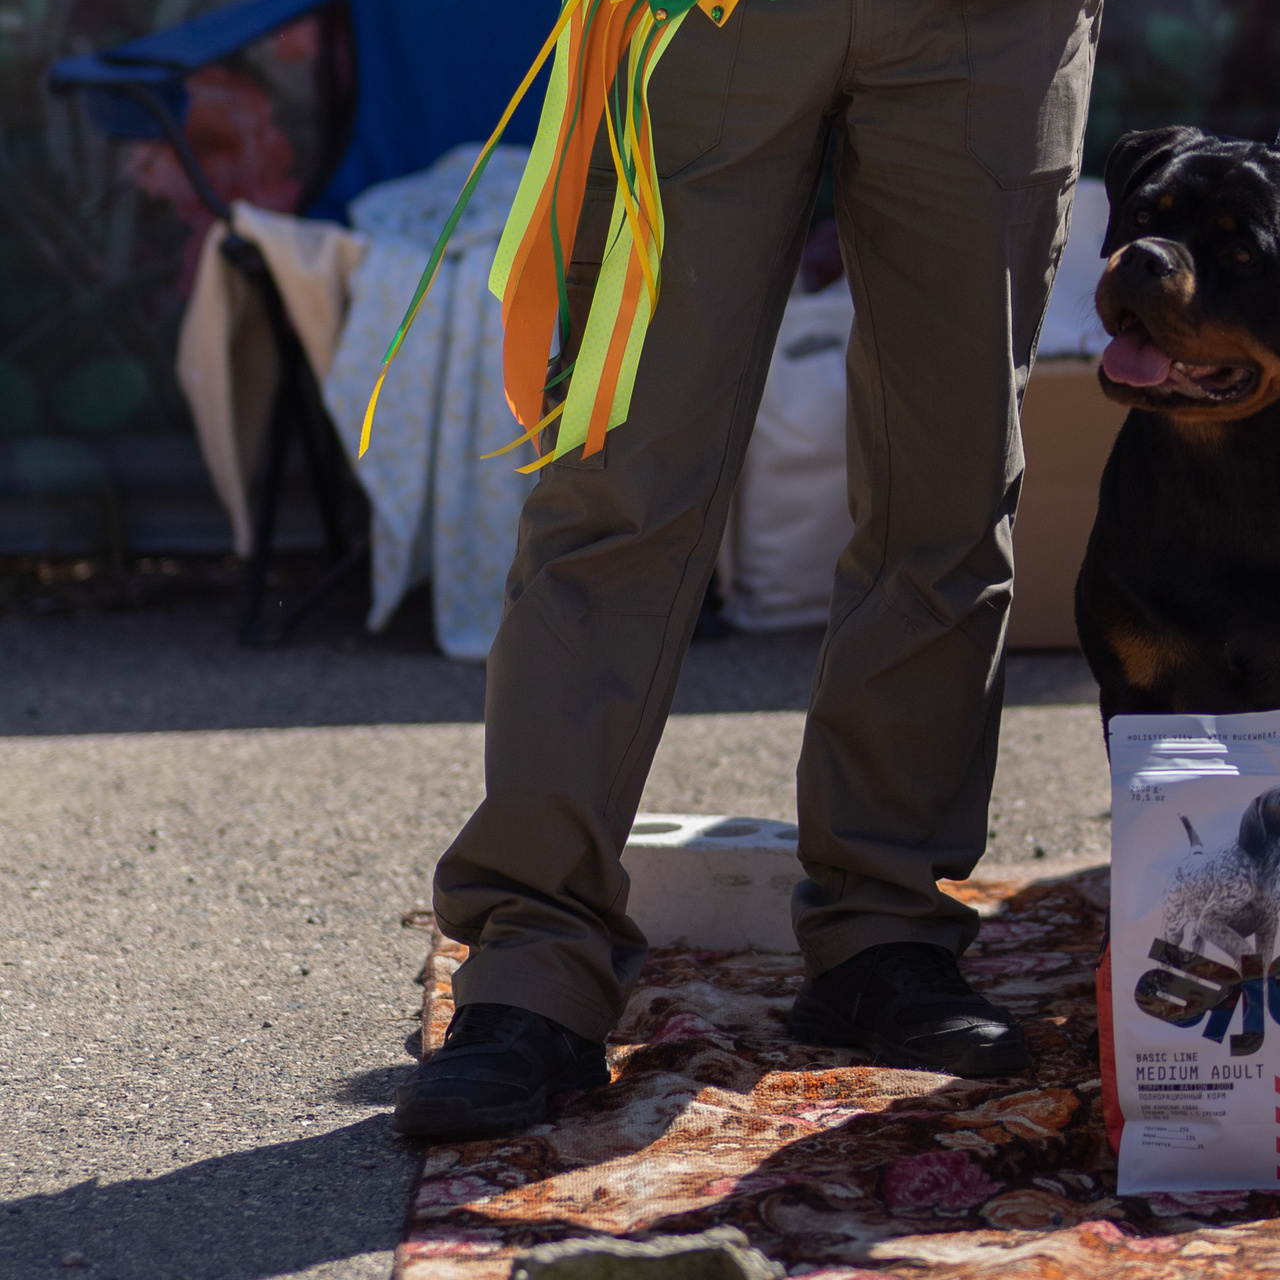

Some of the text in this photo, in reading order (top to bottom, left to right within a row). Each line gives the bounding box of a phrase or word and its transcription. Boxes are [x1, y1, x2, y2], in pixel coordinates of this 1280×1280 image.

[1232, 731, 1277, 741] BUCKWHEAT
[1155, 794, 1166, 802] oz
[1136, 1052, 1198, 1062] BASIC LINE
[1136, 1064, 1264, 1081] MEDIUM ADULT
[1139, 1092, 1202, 1101] ПОЛНОРАЦИОННЫЙ
